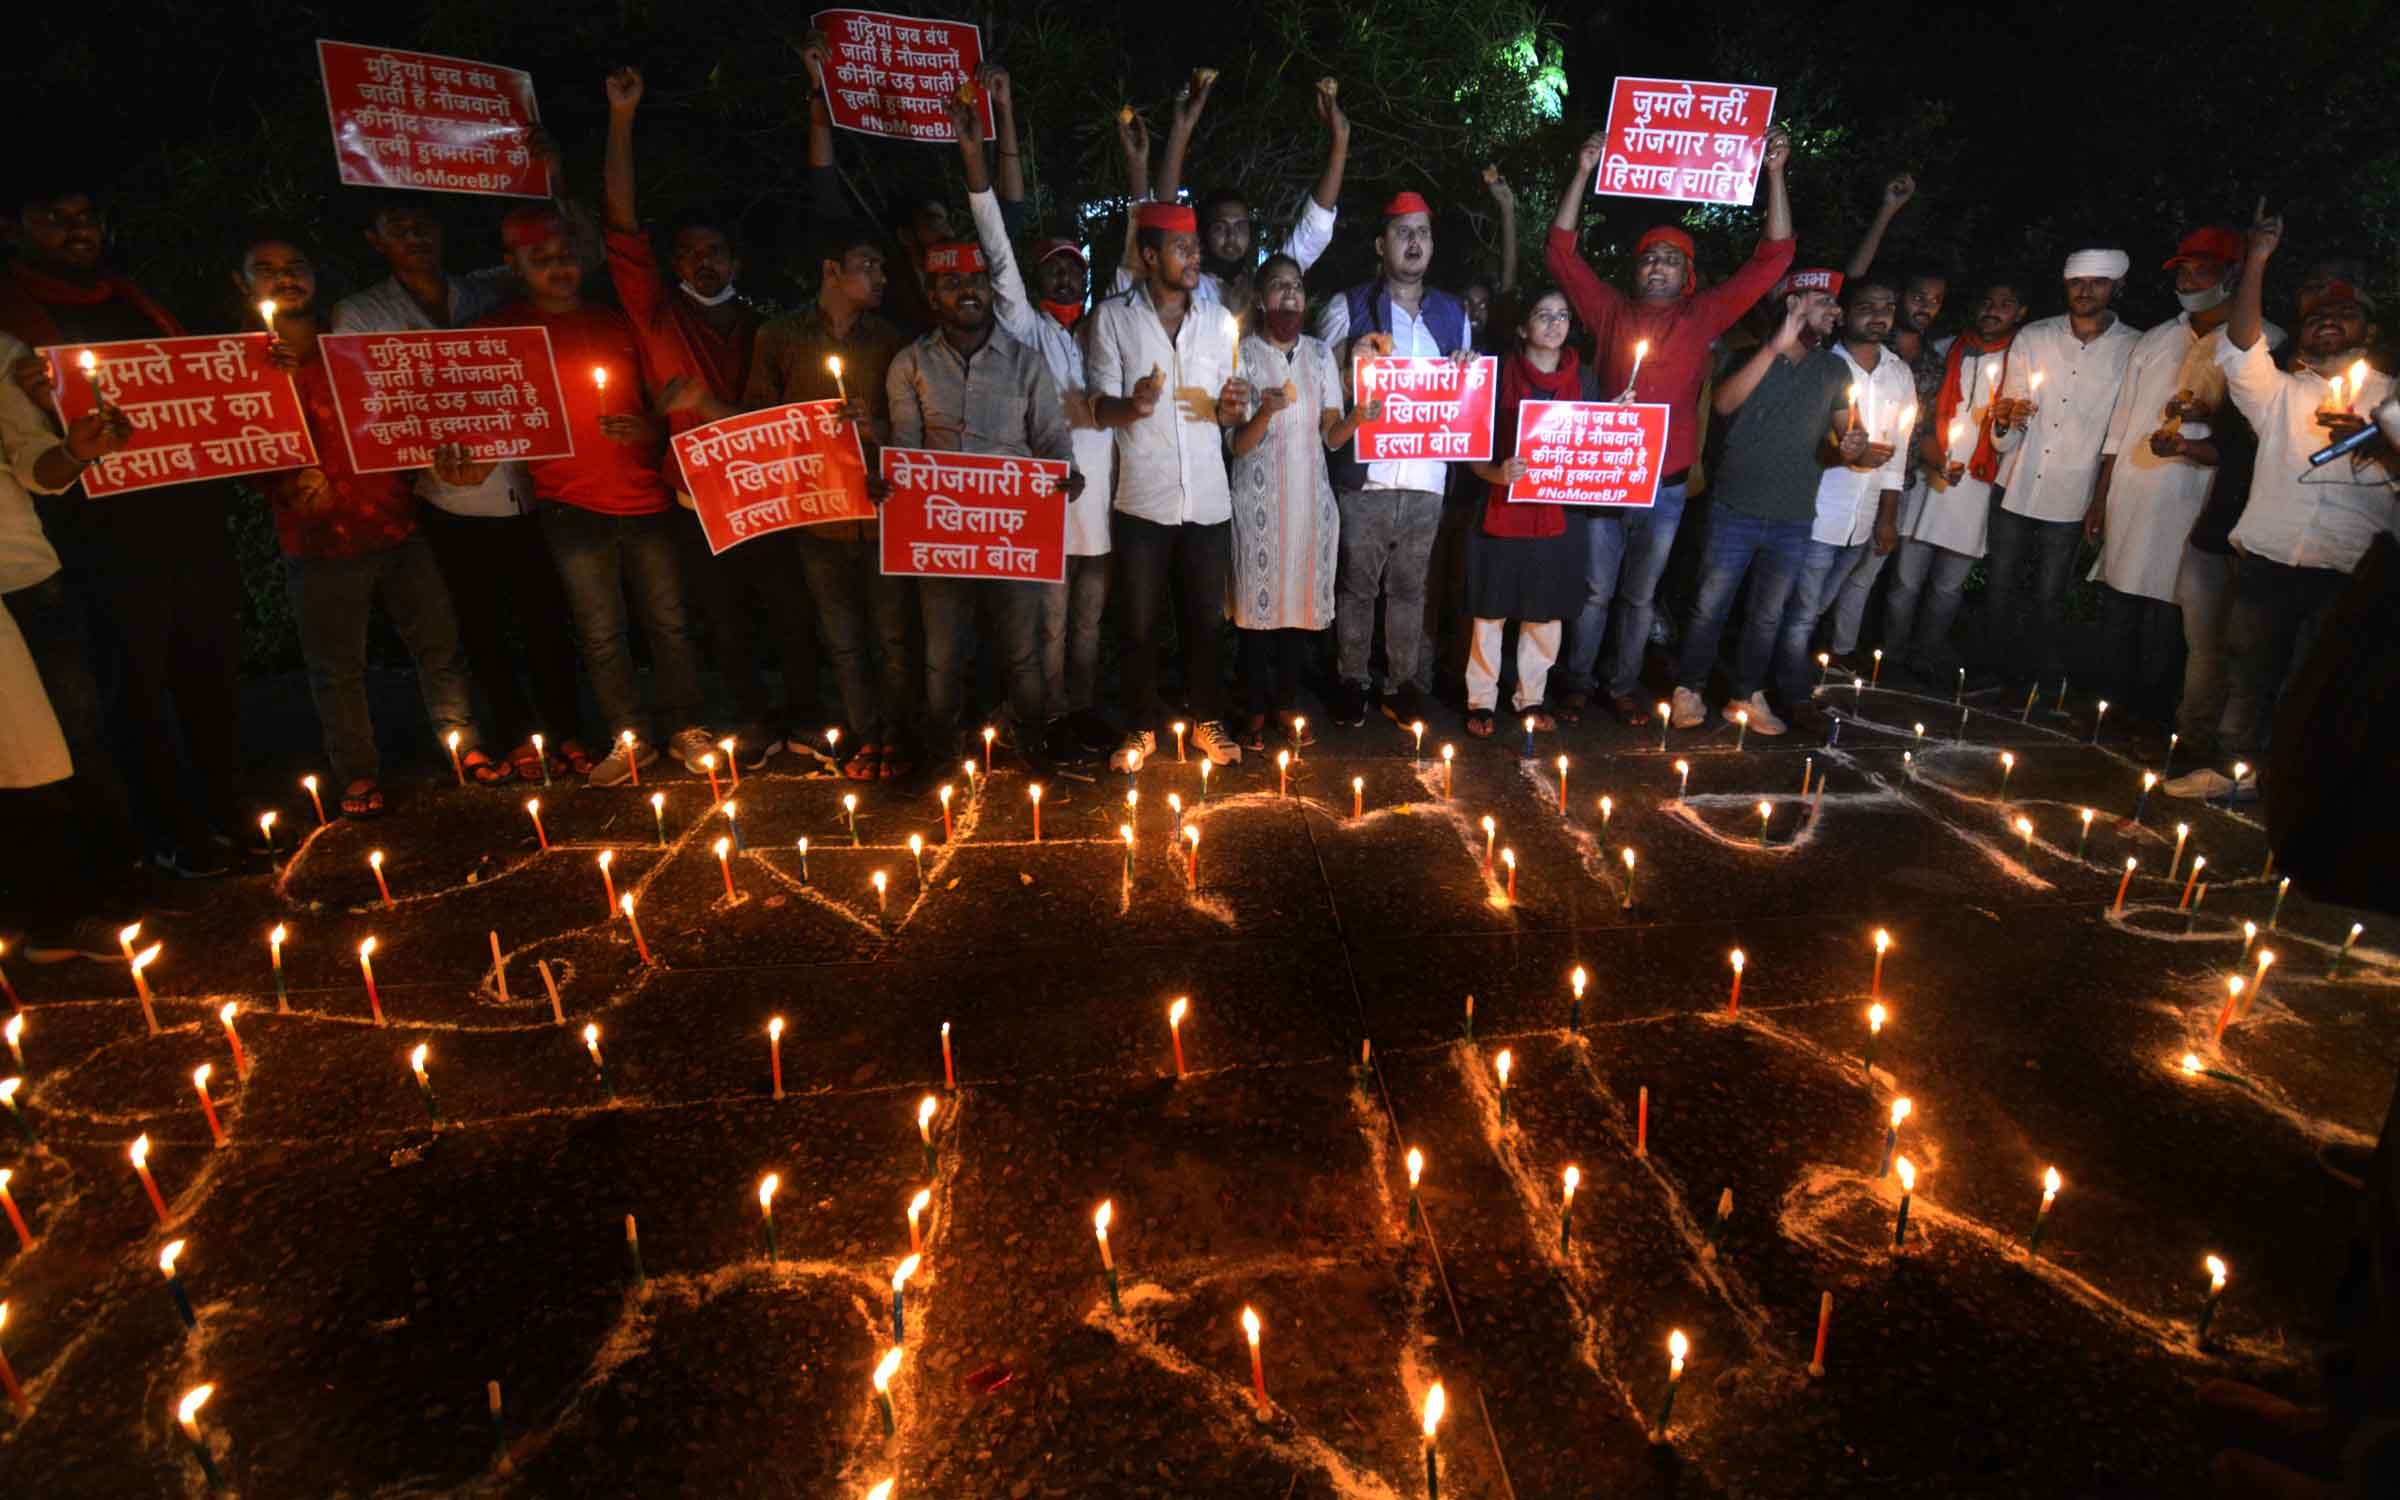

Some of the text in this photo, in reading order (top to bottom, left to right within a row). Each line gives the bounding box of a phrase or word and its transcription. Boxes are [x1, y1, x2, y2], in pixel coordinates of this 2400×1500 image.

[840, 38, 877, 62] जाती
[895, 26, 921, 45] जब
[924, 26, 949, 46] बंध
[357, 79, 405, 105] जाती
[431, 66, 462, 85] जब
[467, 68, 497, 90] बंध
[889, 72, 916, 93] उड़
[919, 73, 955, 92] जाती
[1632, 84, 1695, 124] जुमले
[1624, 117, 1749, 158] रोजगार का
[1604, 153, 1677, 191] हिसाब
[438, 340, 472, 358] जब
[476, 336, 508, 356] बंध
[364, 361, 415, 388] जाती
[223, 391, 275, 420] का
[432, 391, 467, 411] उड़
[472, 383, 519, 406] जाती
[522, 381, 538, 407] है
[1385, 393, 1462, 423] खिलाफ
[522, 407, 551, 429] की
[1591, 411, 1615, 426] जब
[1618, 409, 1639, 426] बंध
[200, 427, 306, 465] चाहिए
[685, 405, 842, 467] बेरोजगारी के
[1374, 425, 1472, 457] हल्ला बोल
[1539, 427, 1570, 446] जाती
[1577, 450, 1599, 467] उड़
[1603, 448, 1634, 465] जाती
[1636, 447, 1648, 466] है
[725, 453, 825, 496] खिलाफ
[892, 453, 1060, 498] बेरोजगारी के
[1629, 467, 1648, 484] की
[1536, 487, 1627, 501] #NoMoreBJP
[726, 483, 848, 536] हल्ला बोल
[924, 494, 1027, 533] खिलाफ
[909, 537, 1039, 573] हल्ला बोल
